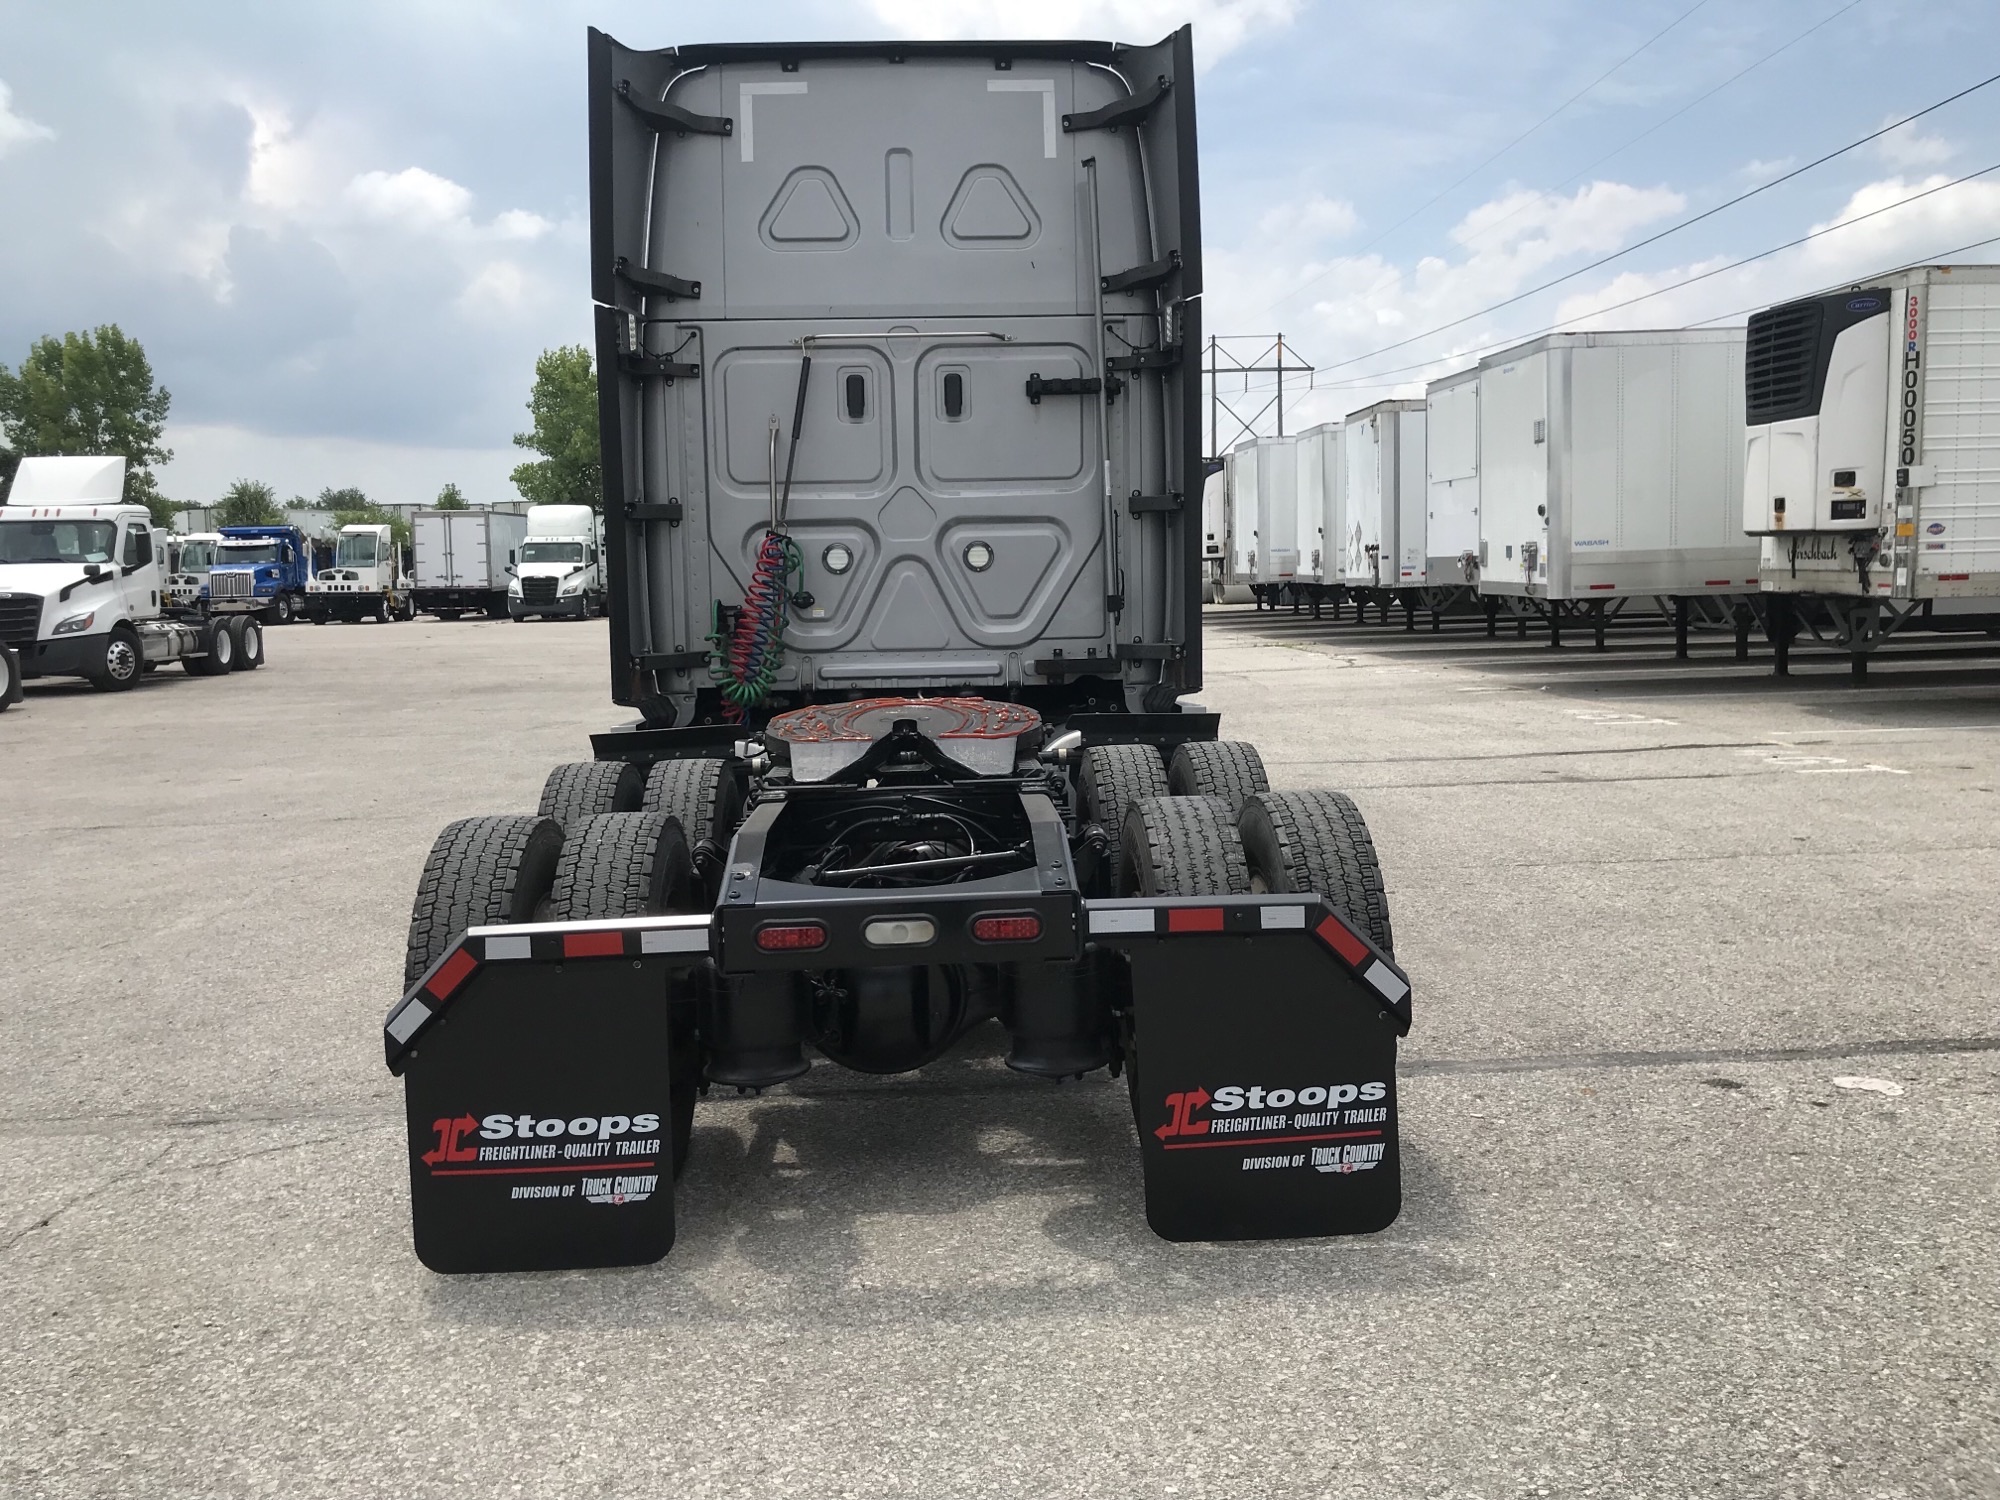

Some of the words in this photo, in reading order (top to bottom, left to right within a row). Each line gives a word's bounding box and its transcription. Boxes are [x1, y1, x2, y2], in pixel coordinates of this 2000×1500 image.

[1850, 301, 1877, 309] Carrier
[1908, 296, 1918, 352] 3000R
[1901, 351, 1920, 466] H00050
[1574, 539, 1609, 547] WABASH
[1210, 1081, 1387, 1112] Stoops
[1344, 1107, 1387, 1125] TRAILER
[479, 1113, 660, 1140] Stoops
[615, 1139, 660, 1155] TRAILER
[1310, 1146, 1342, 1166] TRUCK
[1342, 1142, 1386, 1164] COUNTRY
[1242, 1156, 1290, 1171] DIVISION
[1292, 1154, 1306, 1167] OF
[511, 1186, 560, 1200] DIVISION
[562, 1185, 576, 1197] OF
[581, 1177, 612, 1196] TRUCK
[613, 1174, 659, 1194] COUNTRY
